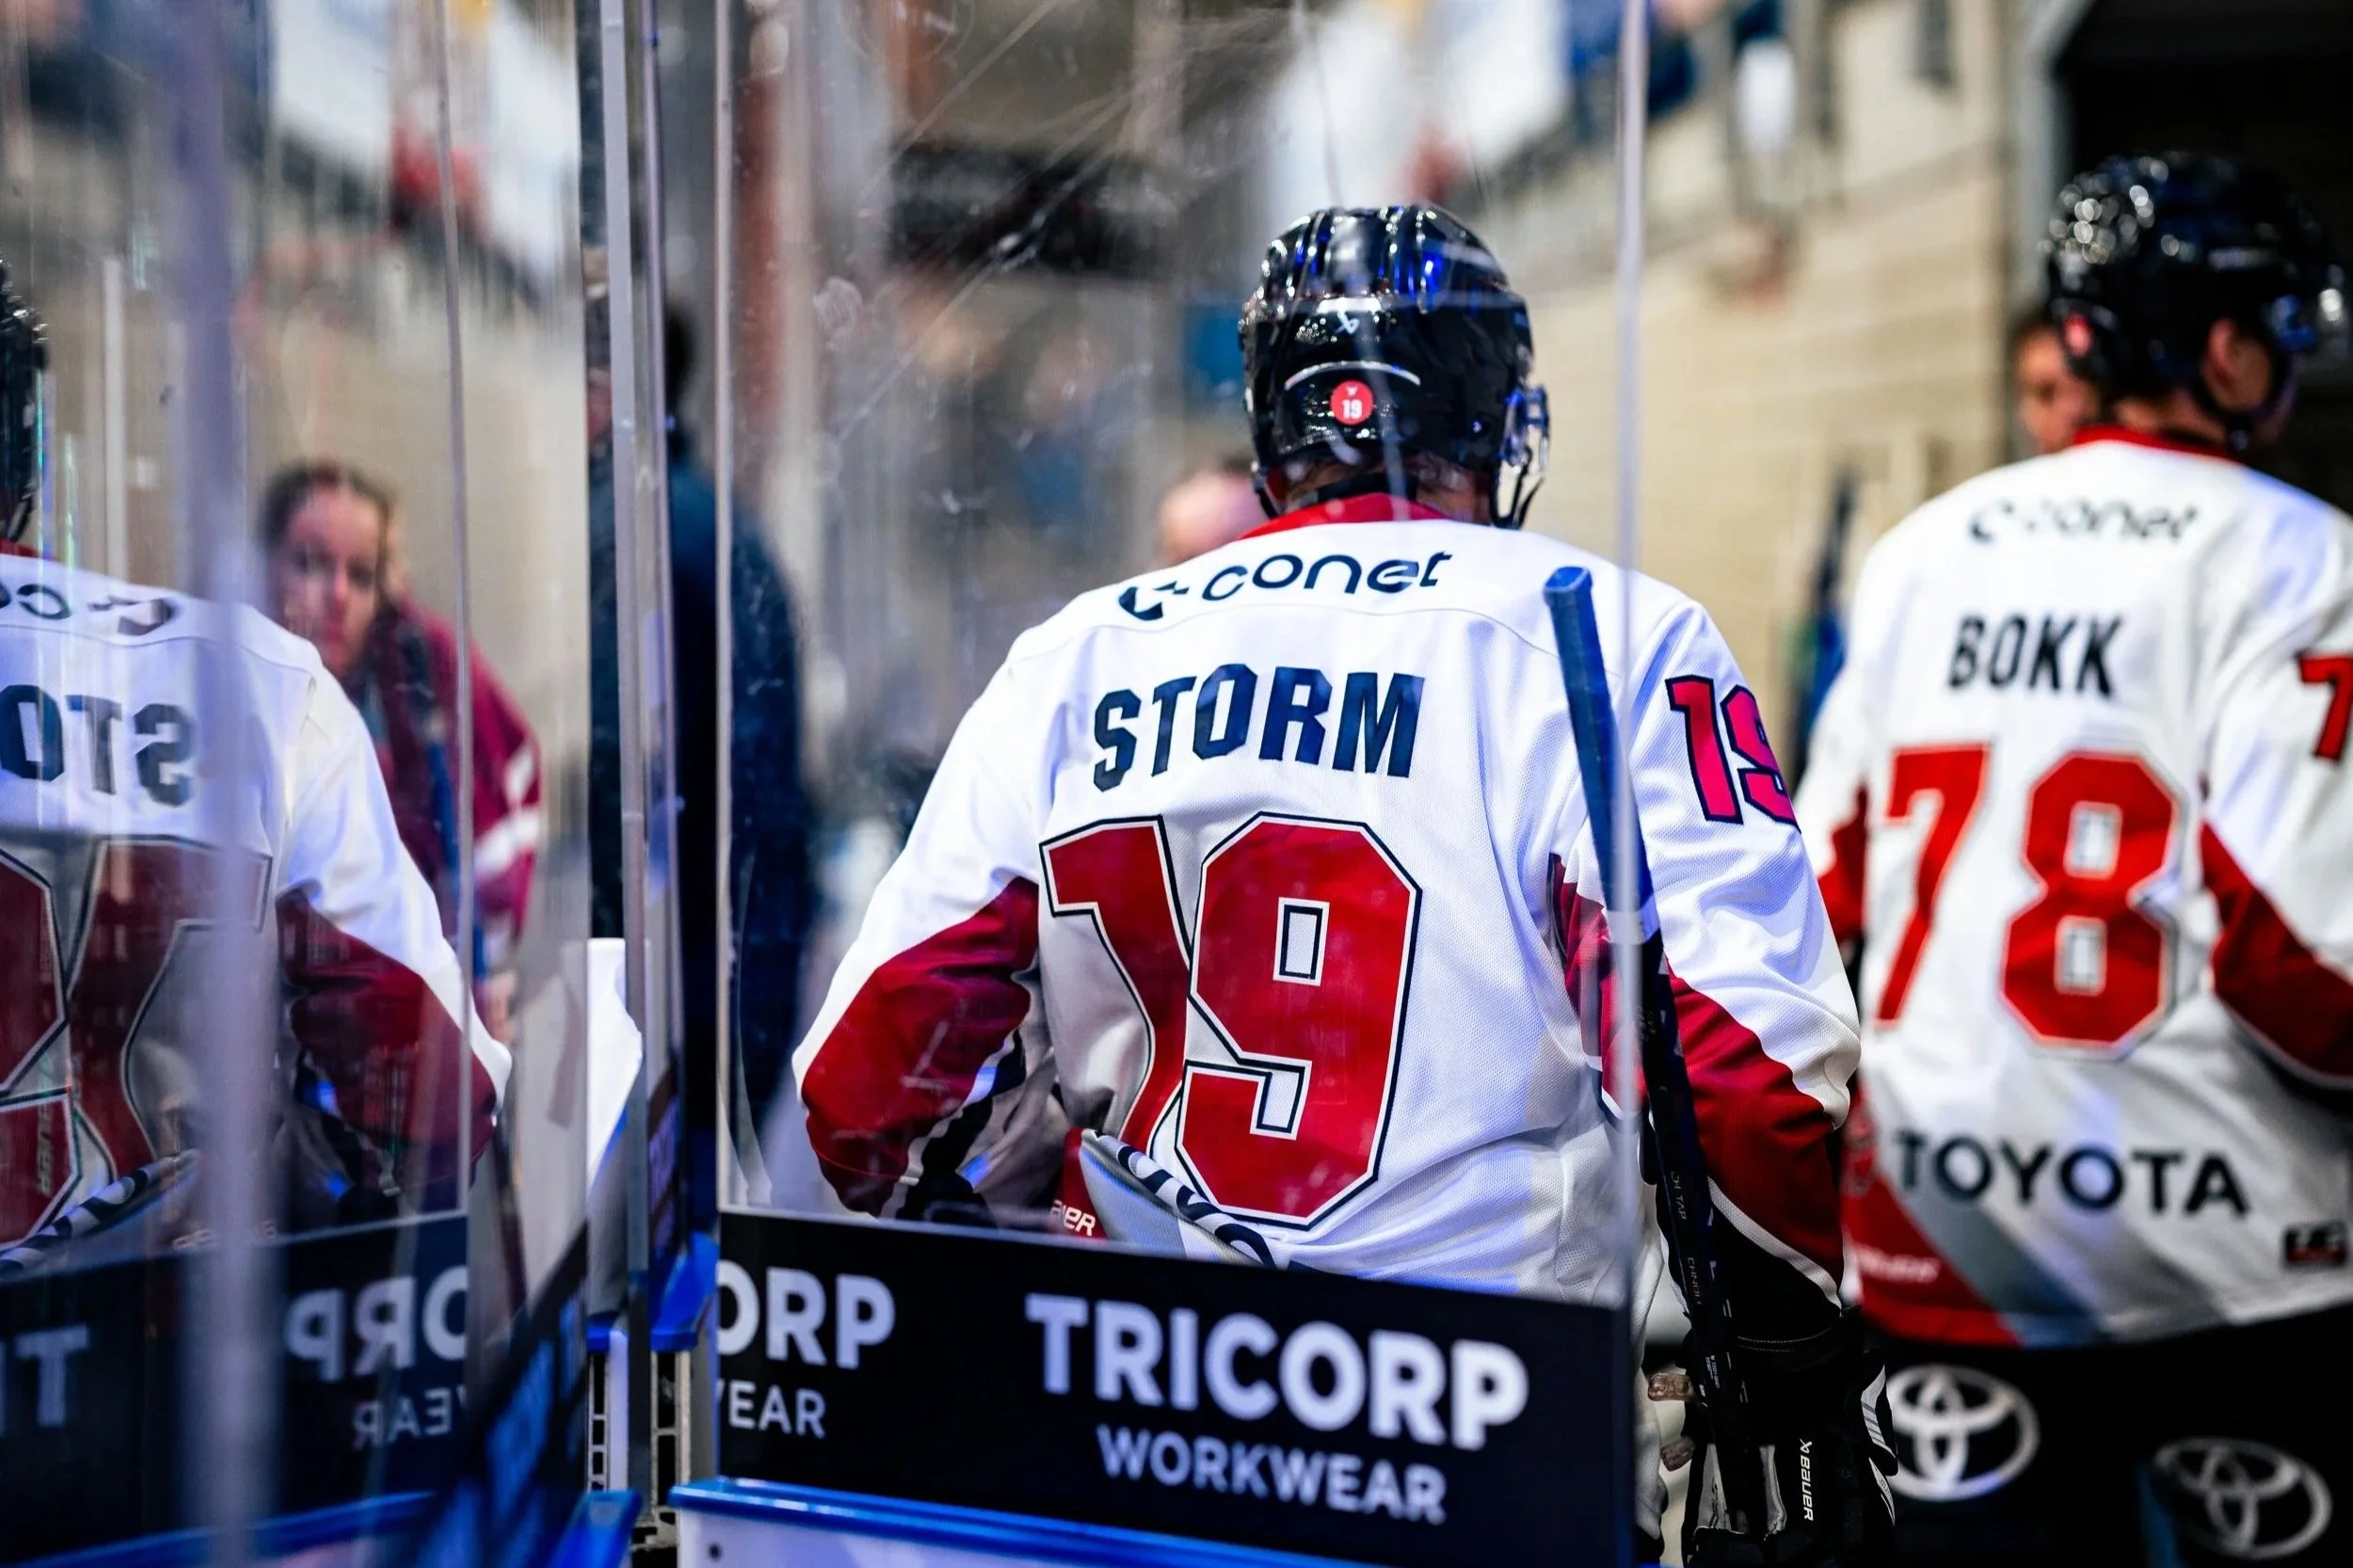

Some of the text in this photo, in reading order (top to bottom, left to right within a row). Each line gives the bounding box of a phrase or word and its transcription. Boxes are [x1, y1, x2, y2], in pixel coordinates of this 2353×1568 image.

[1342, 399, 1363, 420] 19
[1202, 552, 1452, 601] conet
[1948, 614, 2123, 697] BOKK
[1093, 663, 1425, 792] STORM
[1876, 742, 2184, 1052] 78
[1039, 811, 1423, 1231] 19
[1895, 1131, 2249, 1218] TOYOTA
[716, 1378, 826, 1440] EAR
[1026, 1293, 1529, 1450] TRICORP
[1096, 1423, 1448, 1526] WORKWEAR
